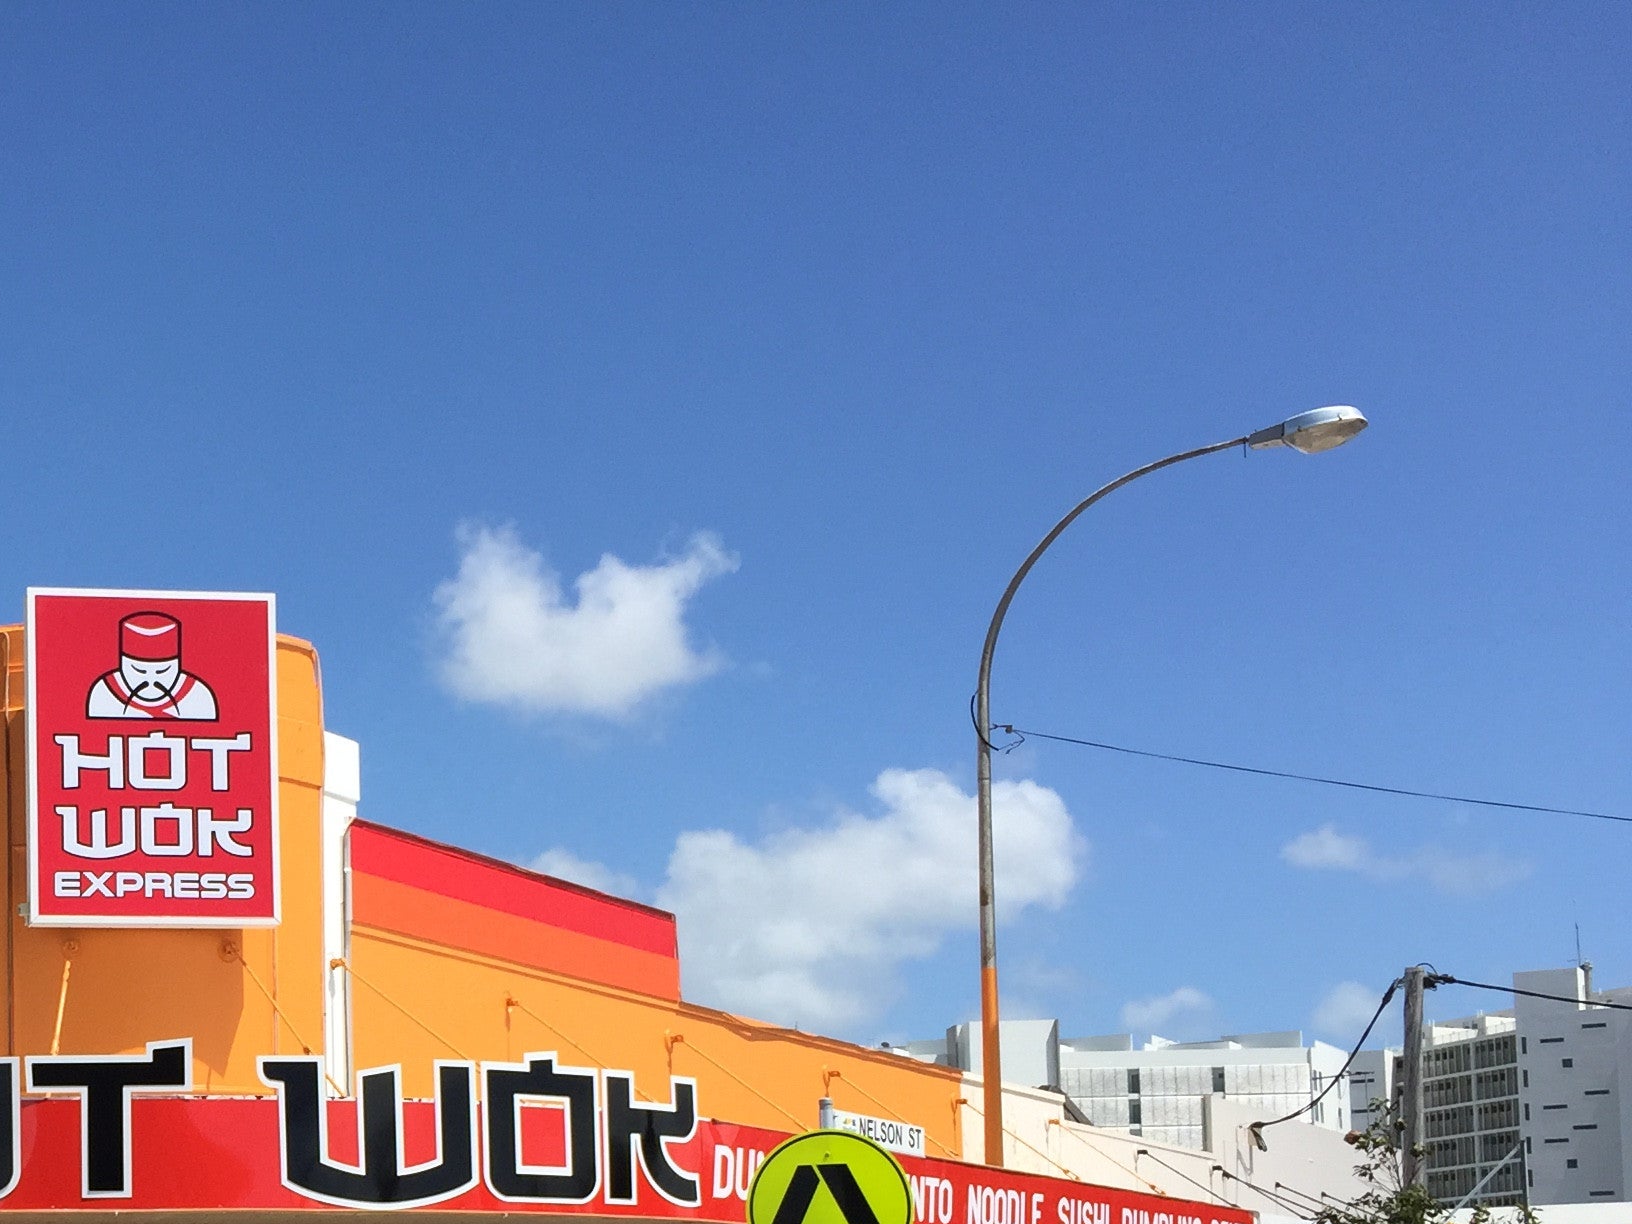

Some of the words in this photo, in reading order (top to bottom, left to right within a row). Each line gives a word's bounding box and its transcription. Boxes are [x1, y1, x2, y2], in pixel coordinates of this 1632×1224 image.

[53, 730, 252, 791] HOT
[54, 802, 254, 859] WOK
[53, 871, 255, 899] EXPRESS
[256, 1050, 700, 1210] WOK
[859, 1118, 903, 1146] NELSON
[908, 1128, 922, 1149] ST
